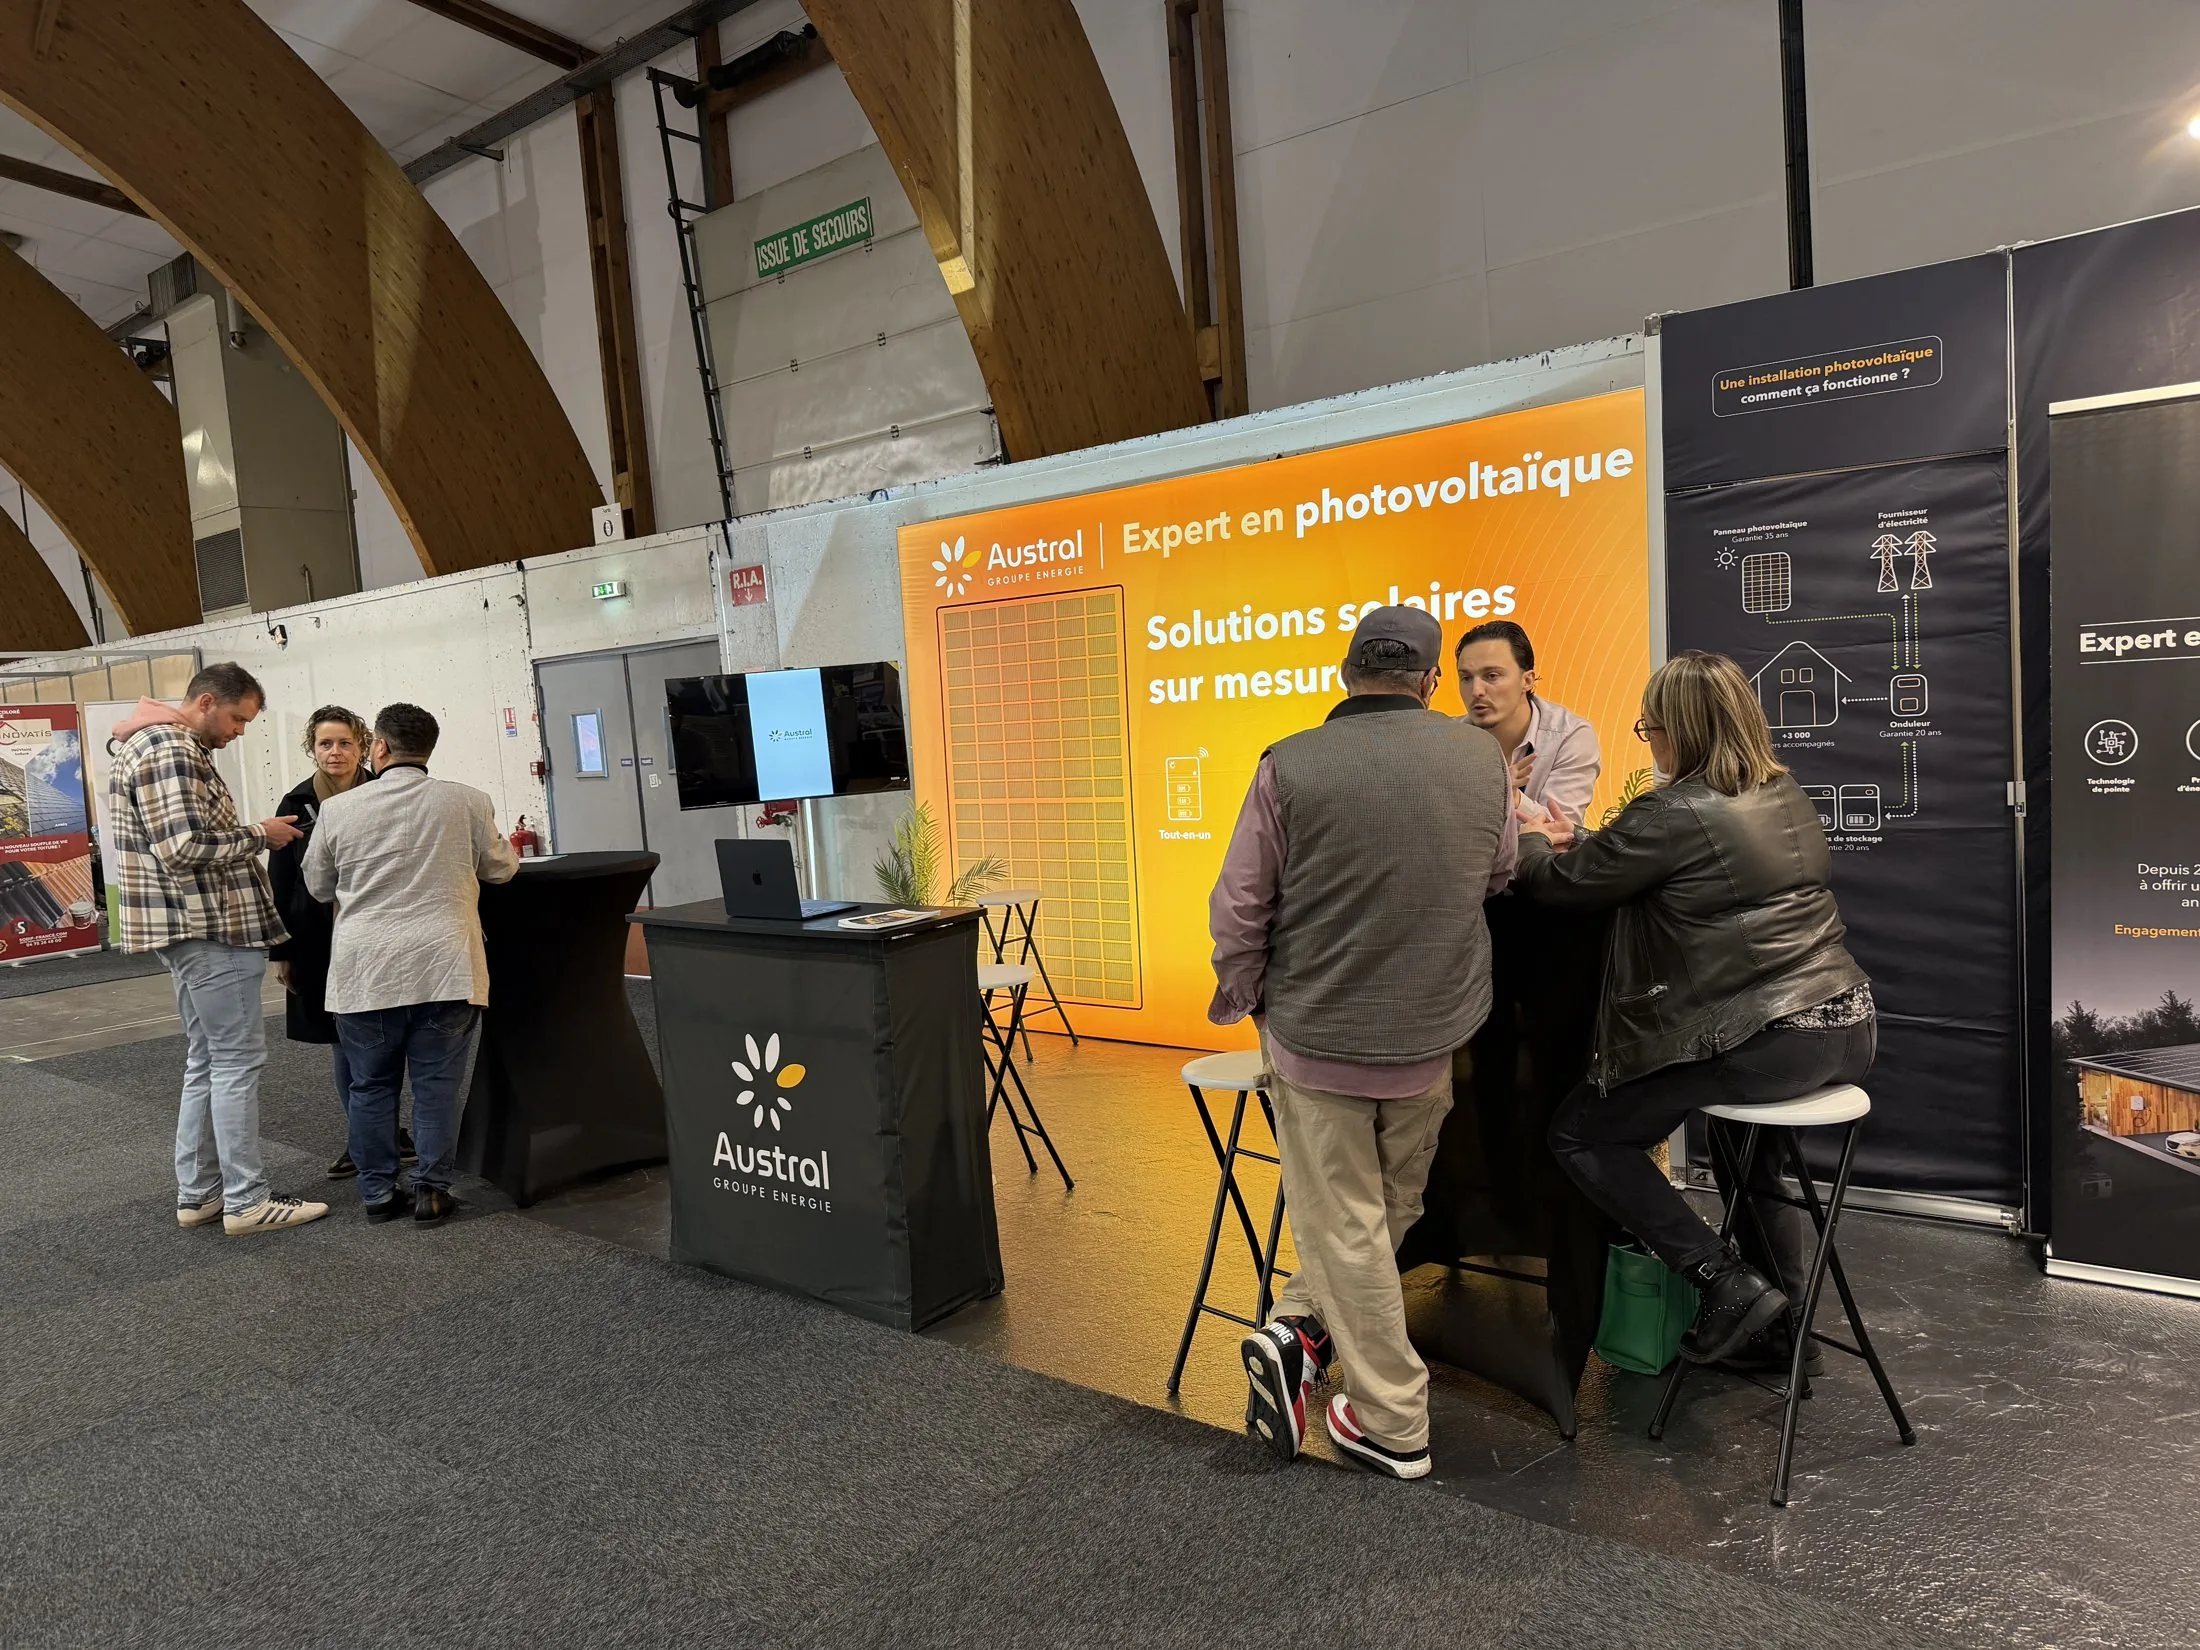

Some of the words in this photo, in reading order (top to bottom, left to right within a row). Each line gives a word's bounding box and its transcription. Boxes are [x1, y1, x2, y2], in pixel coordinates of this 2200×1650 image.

[757, 236, 791, 271] ISSUE
[792, 229, 810, 258] DE
[811, 205, 868, 250] SECOURS
[1720, 378, 1745, 391] Une
[1748, 366, 1821, 386] installation
[1824, 347, 1933, 377] photovoltaïque
[1740, 386, 1802, 404] comment
[1805, 384, 1820, 397] ça
[1823, 371, 1898, 391] fonctionne
[1901, 367, 1910, 379] ?
[1122, 511, 1231, 559] Expert
[1241, 506, 1284, 536] en
[1295, 446, 1634, 538] photovoltaïque
[1877, 508, 1928, 520] Fournisseur
[1713, 526, 1746, 536] Panneau
[1747, 520, 1808, 534] photovoltaïque
[1731, 534, 1763, 543] Garantie
[1764, 532, 1774, 540] 35
[987, 529, 1083, 571] Austral
[733, 569, 763, 589] R.I.A.
[987, 573, 1031, 587] GROUPE
[1036, 565, 1084, 580] ENERGIE
[1147, 604, 1326, 651] Solutions
[2080, 629, 2177, 657] Expert
[1149, 675, 1204, 705] sur
[1889, 720, 1931, 728] Onduleur
[784, 728, 813, 737] Austral
[1797, 731, 1811, 739] 000
[1879, 730, 1914, 738] Garantie
[1915, 729, 1926, 737] 20
[1782, 740, 1835, 749] accompagnés
[2087, 777, 2135, 787] Technologie
[2092, 785, 2102, 794] de
[2103, 785, 2130, 795] pointe
[1158, 829, 1212, 840] Tout-en-un
[1833, 834, 1844, 842] de
[1845, 834, 1883, 844] stockage
[1844, 843, 1855, 851] 20
[2137, 863, 2190, 878] Depuis
[2139, 880, 2148, 891] à
[2152, 878, 2187, 891] offrir
[713, 1131, 830, 1190] Austral
[713, 1177, 766, 1198] GROUPE
[773, 1189, 832, 1213] ENERGIE
